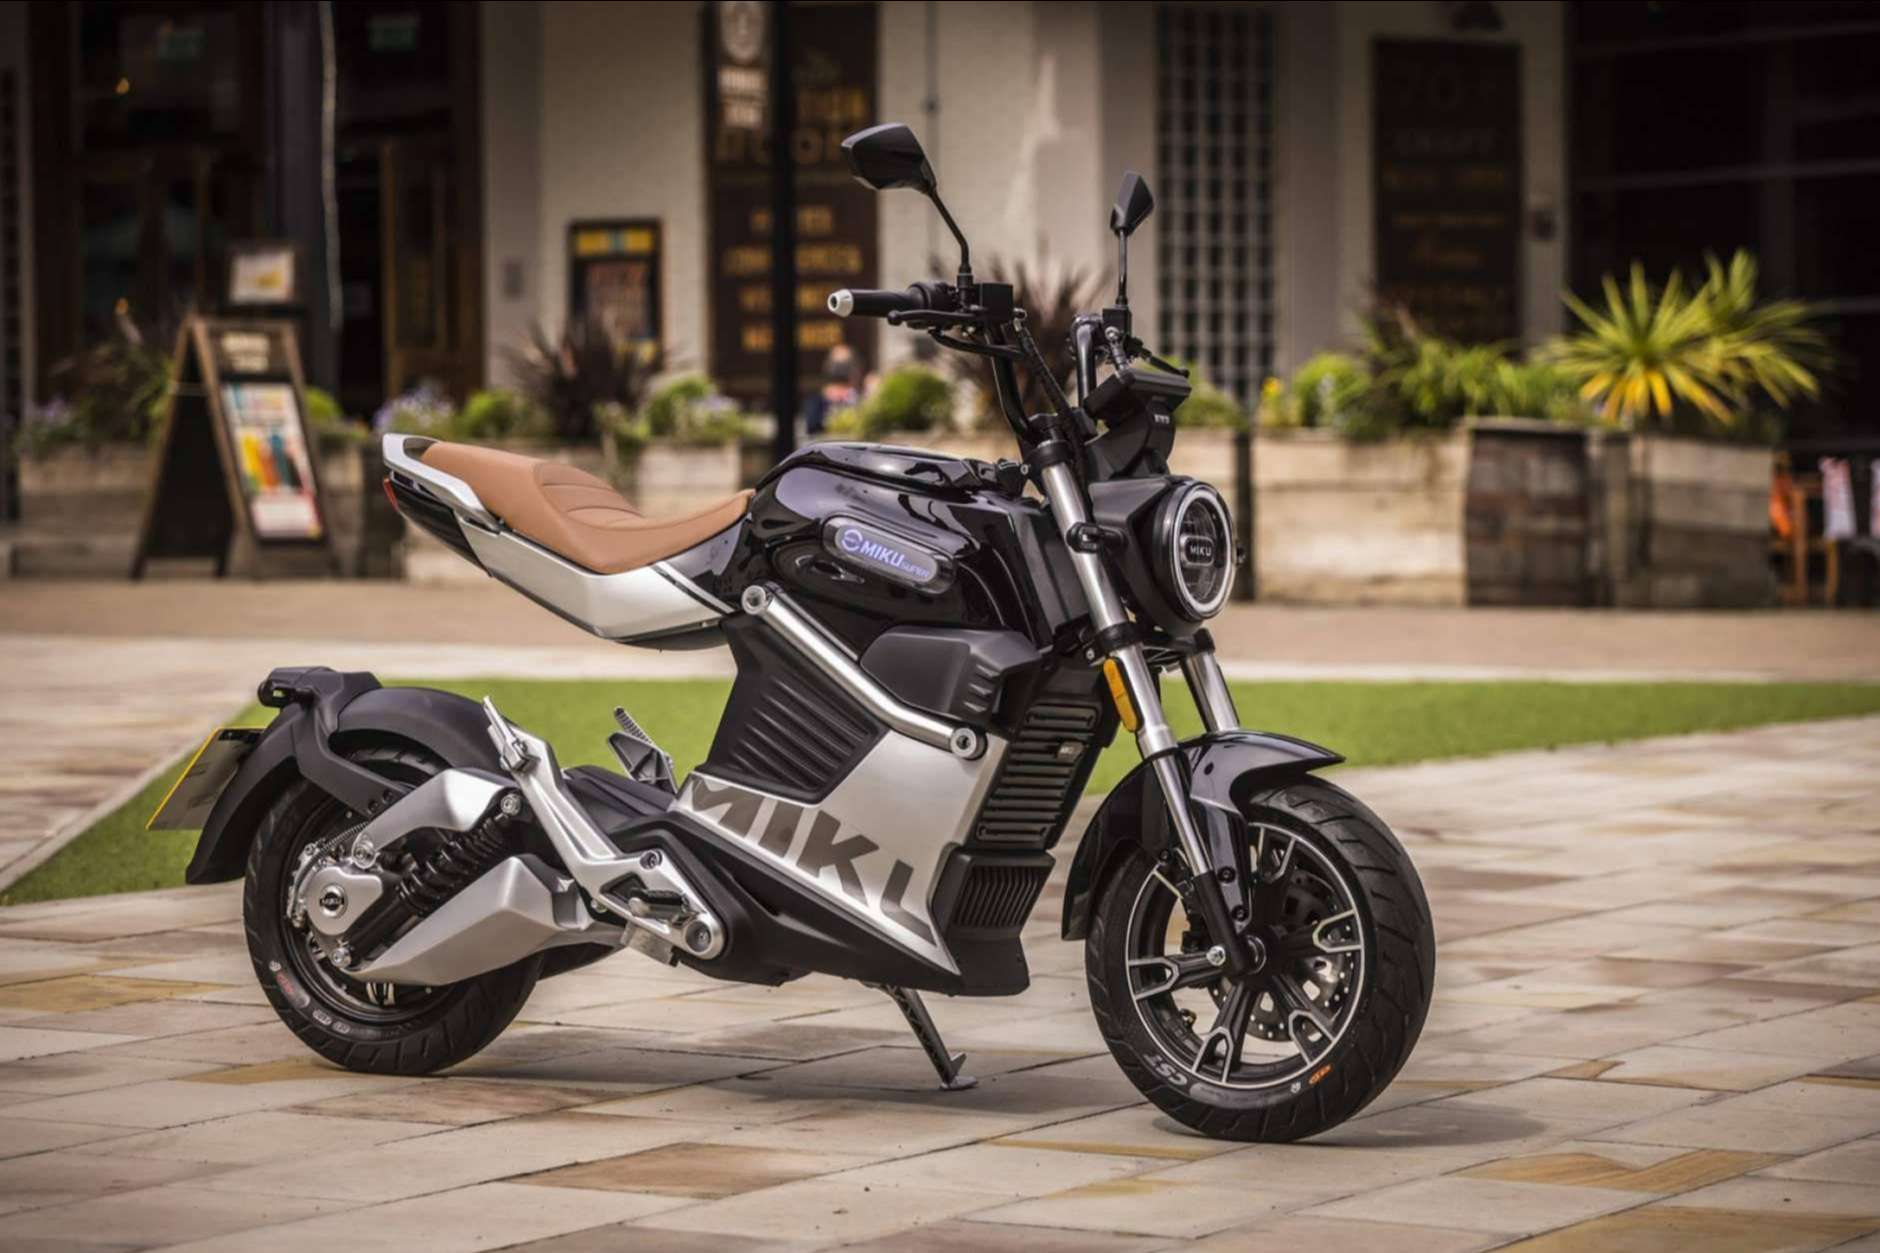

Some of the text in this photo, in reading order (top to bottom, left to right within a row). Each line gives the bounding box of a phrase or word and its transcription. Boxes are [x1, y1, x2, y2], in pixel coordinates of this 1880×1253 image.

[860, 541, 905, 567] MIKU
[1189, 545, 1212, 557] MIKU
[1143, 1054, 1187, 1086] CST
